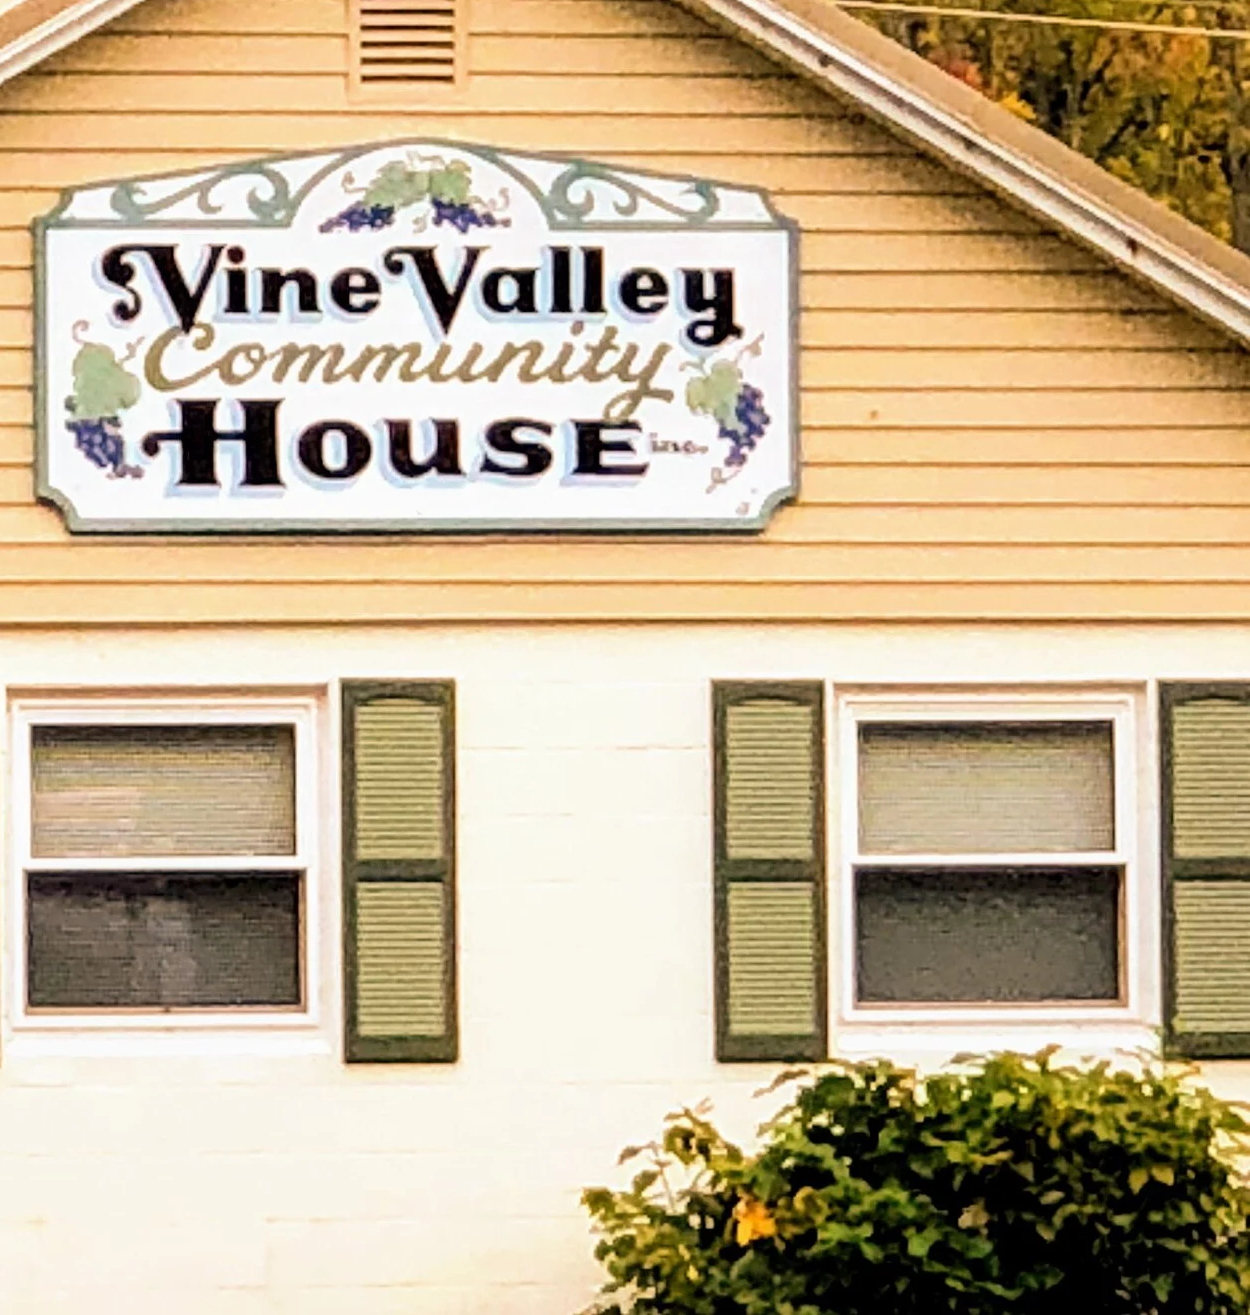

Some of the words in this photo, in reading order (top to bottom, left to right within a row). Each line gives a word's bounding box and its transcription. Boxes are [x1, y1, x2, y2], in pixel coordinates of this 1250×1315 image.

[103, 244, 382, 333] Vine
[384, 244, 743, 346] Valley
[145, 321, 674, 421] Community
